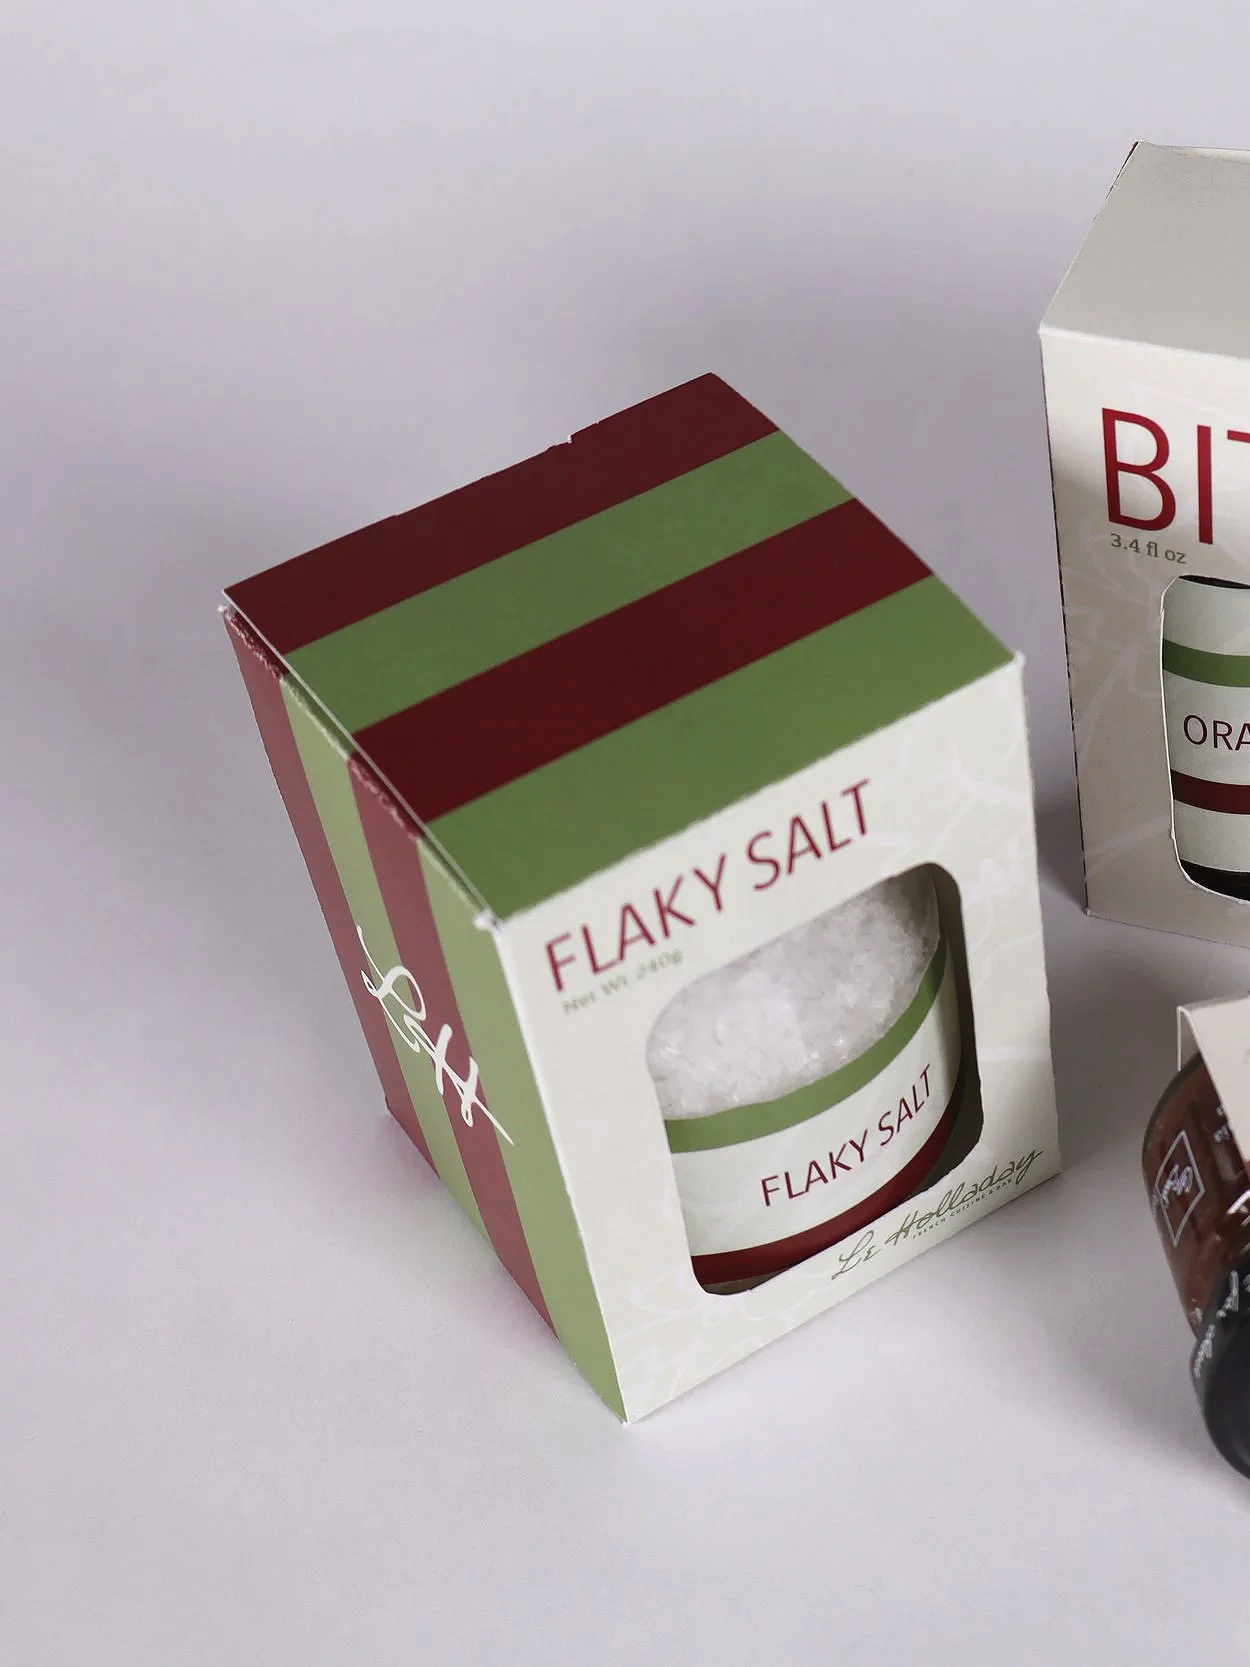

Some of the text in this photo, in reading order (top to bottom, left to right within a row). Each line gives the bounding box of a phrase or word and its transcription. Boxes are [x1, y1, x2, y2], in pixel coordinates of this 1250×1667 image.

[1110, 533, 1187, 564] 3.4 fl oz
[544, 779, 870, 993] FLAKY SALT
[760, 1064, 934, 1207] FLAKY SALT
[884, 1149, 1044, 1246] Holladay
